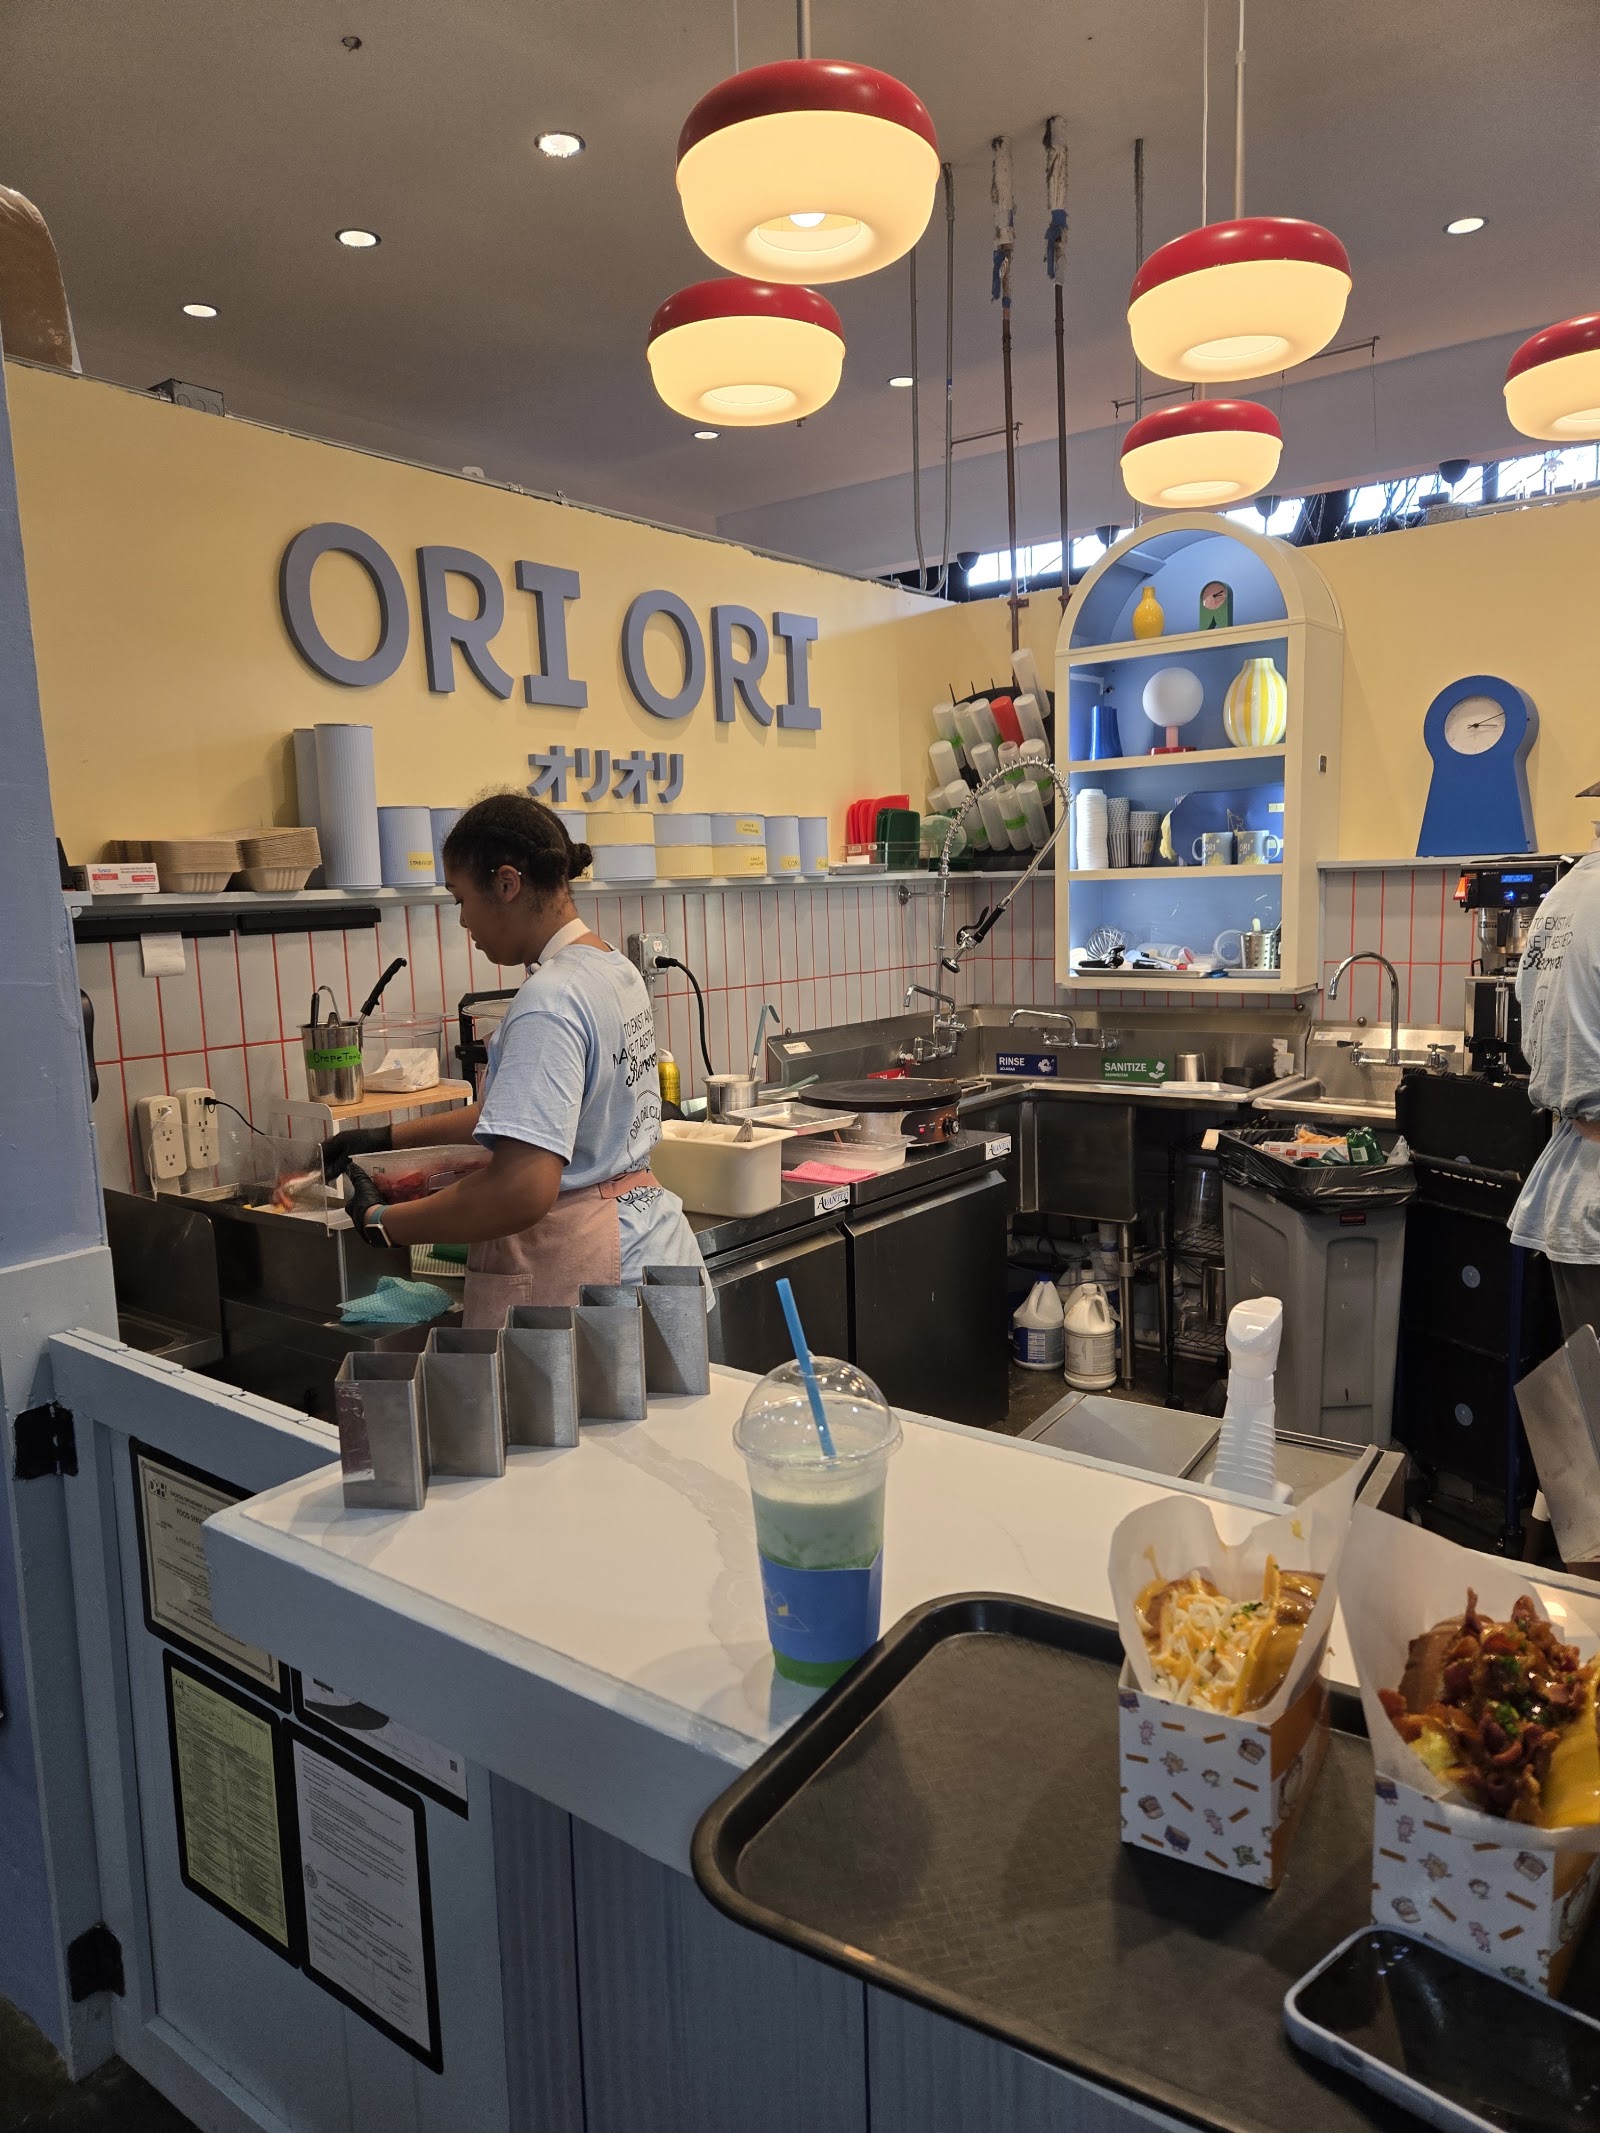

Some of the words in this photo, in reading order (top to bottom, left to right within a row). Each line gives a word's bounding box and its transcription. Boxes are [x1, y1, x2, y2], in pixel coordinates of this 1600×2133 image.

[279, 522, 588, 709] ORI
[621, 590, 822, 731] ORI
[527, 744, 685, 805] オリオリ
[313, 1052, 342, 1064] Crepe
[999, 1056, 1025, 1067] RINSE
[1104, 1062, 1147, 1072] SANITIZE
[816, 1191, 849, 1211] AVANTCO
